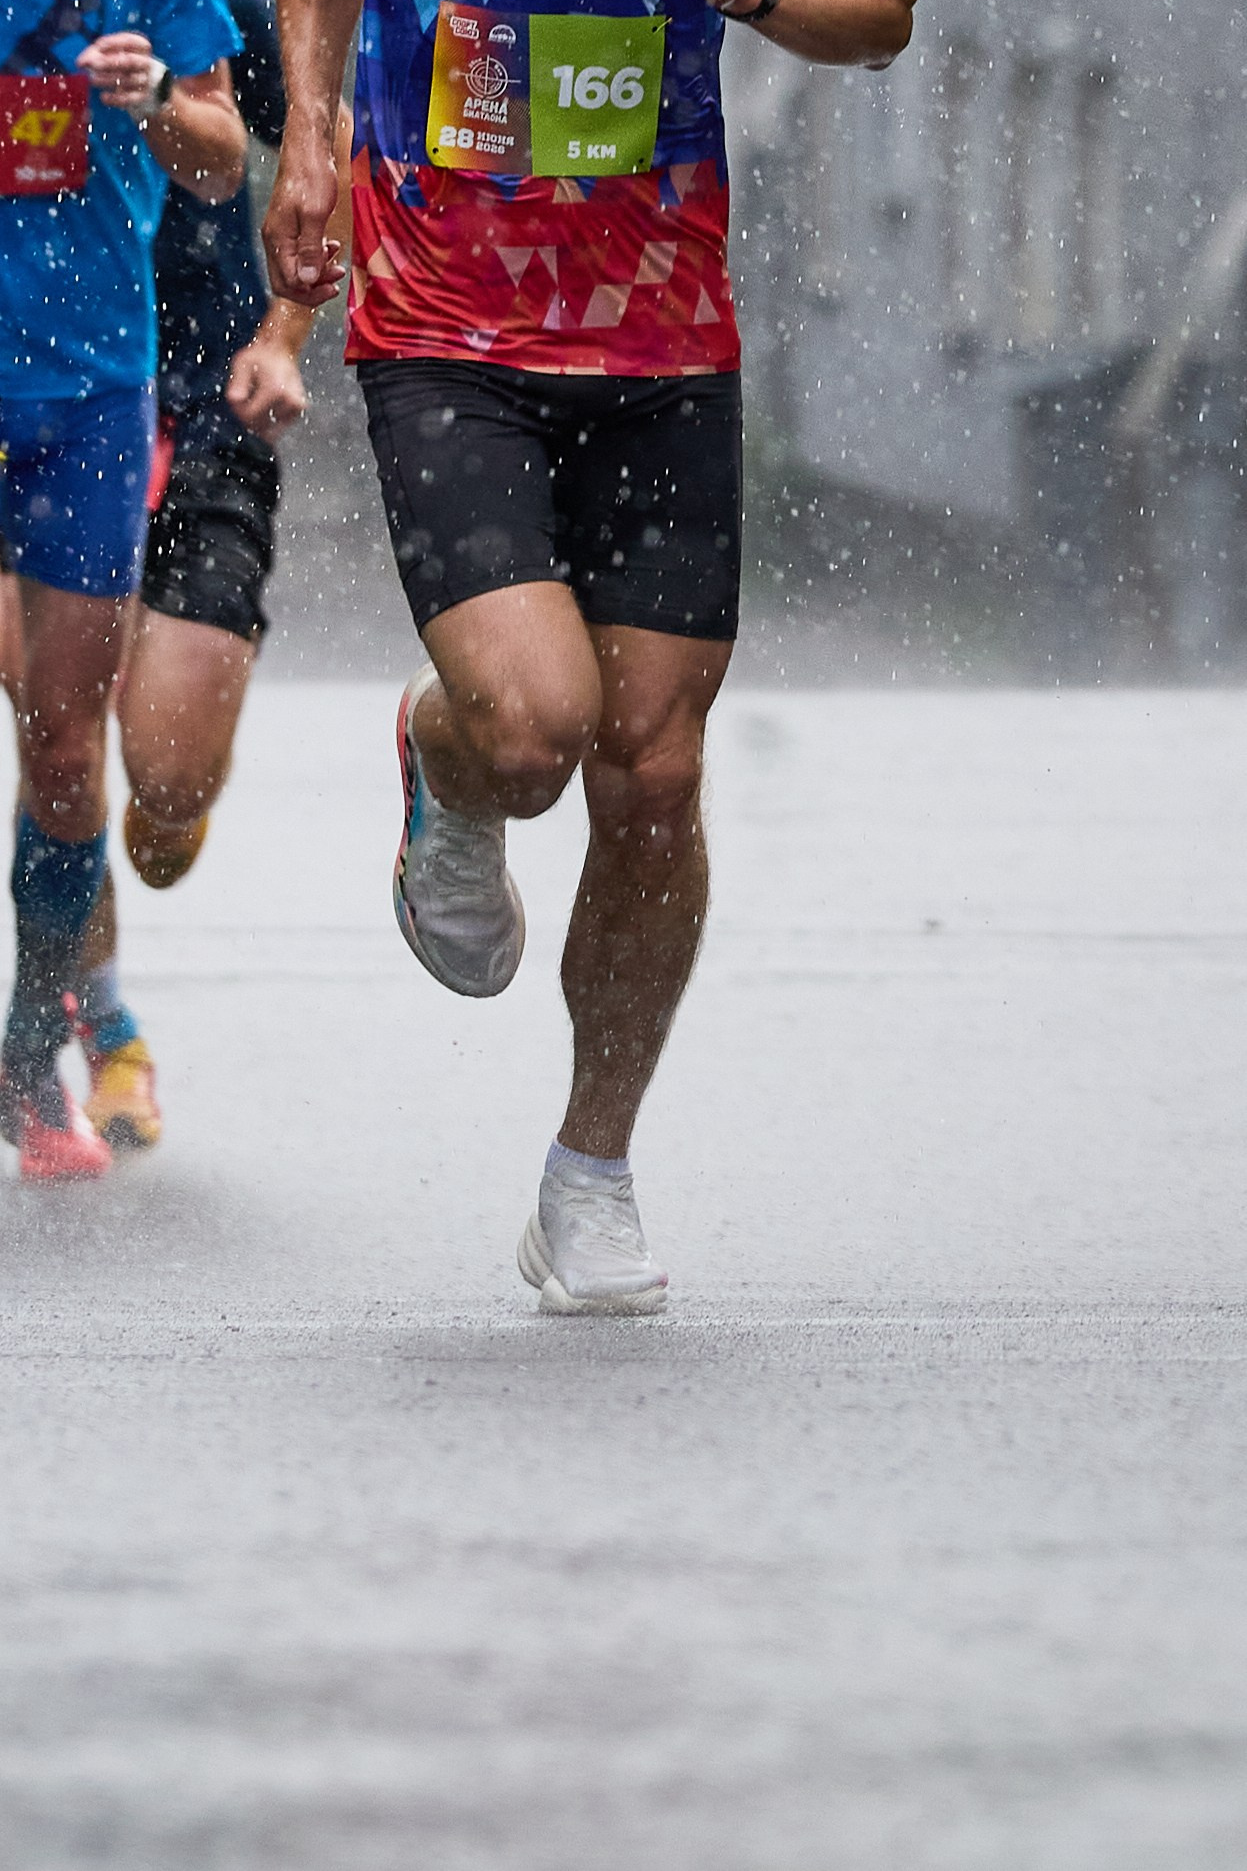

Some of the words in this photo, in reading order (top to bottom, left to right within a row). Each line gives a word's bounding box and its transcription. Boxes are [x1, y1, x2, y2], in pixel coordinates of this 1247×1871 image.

[552, 64, 645, 110] 166
[463, 96, 509, 116] АРЕНА
[463, 109, 508, 124] БИАТЛОНА
[9, 109, 72, 147] 47
[438, 125, 475, 149] 28
[567, 140, 581, 159] 5
